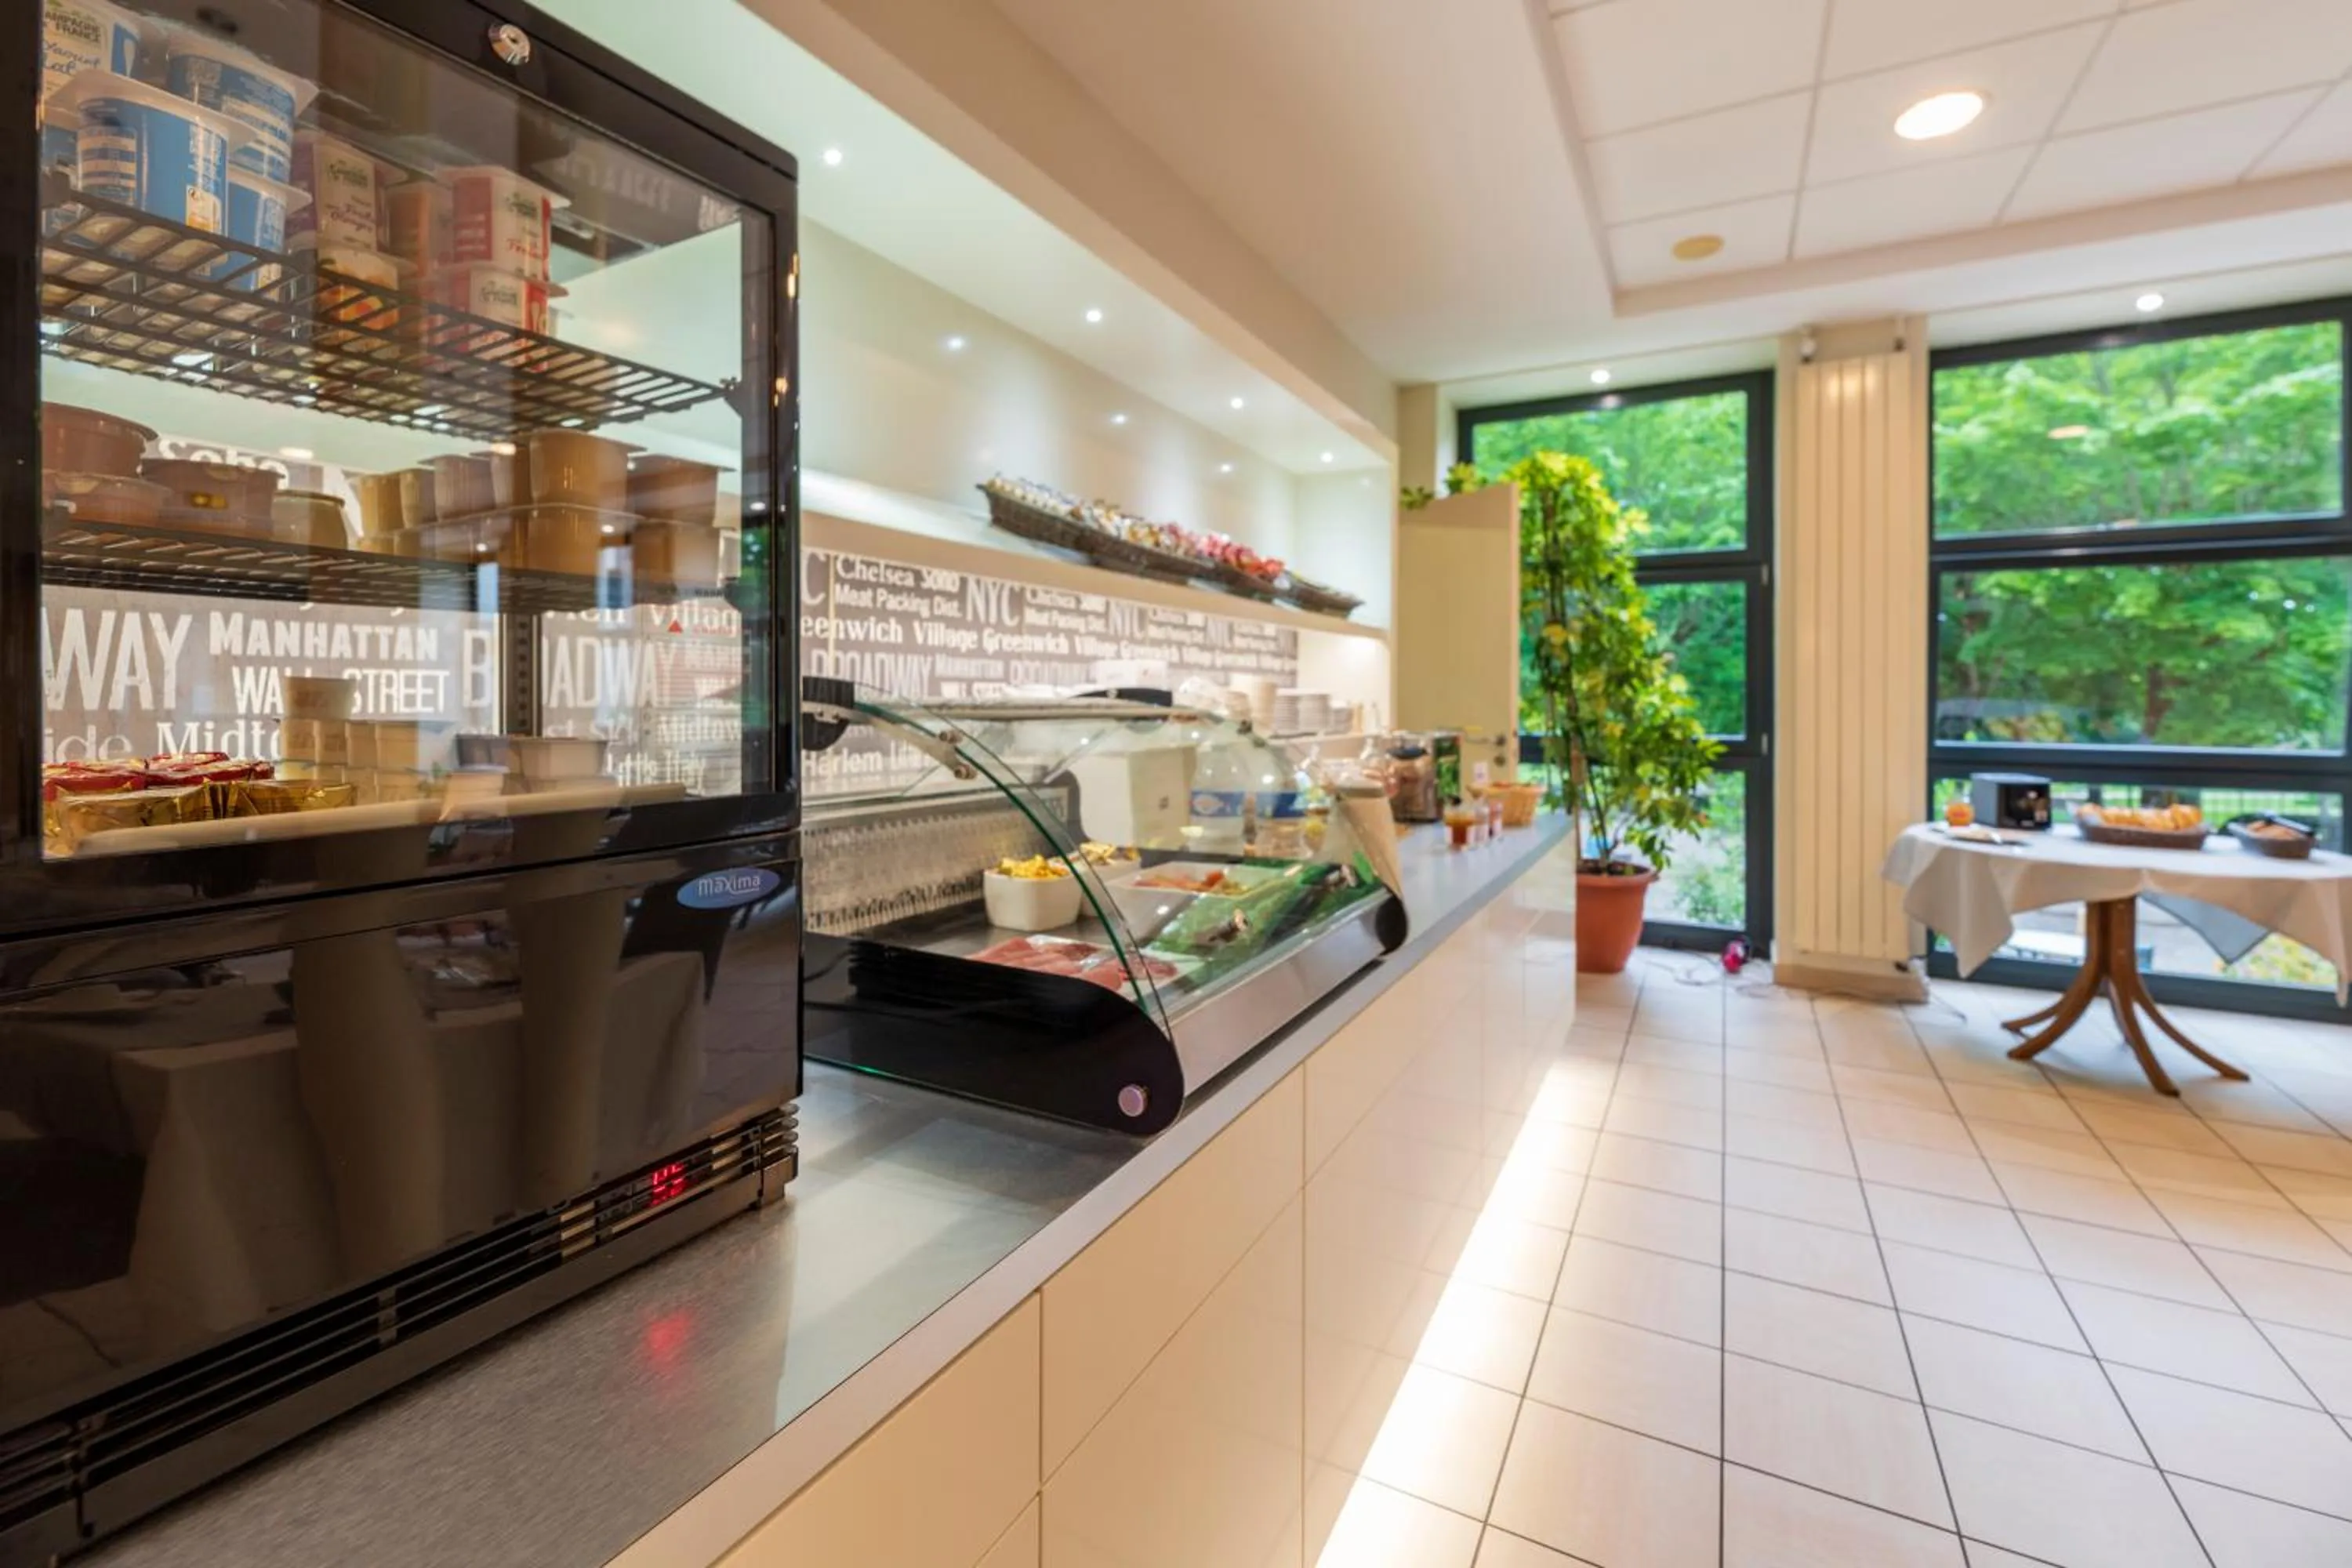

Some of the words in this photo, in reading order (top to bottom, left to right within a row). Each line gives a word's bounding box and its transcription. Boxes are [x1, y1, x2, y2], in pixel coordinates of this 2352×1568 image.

[837, 554, 915, 587] Chelsea
[967, 574, 1020, 626] NYC
[209, 611, 438, 661] MANHATTAN
[647, 601, 740, 638] Villag
[913, 621, 978, 653] Village
[801, 746, 884, 778] Harlem
